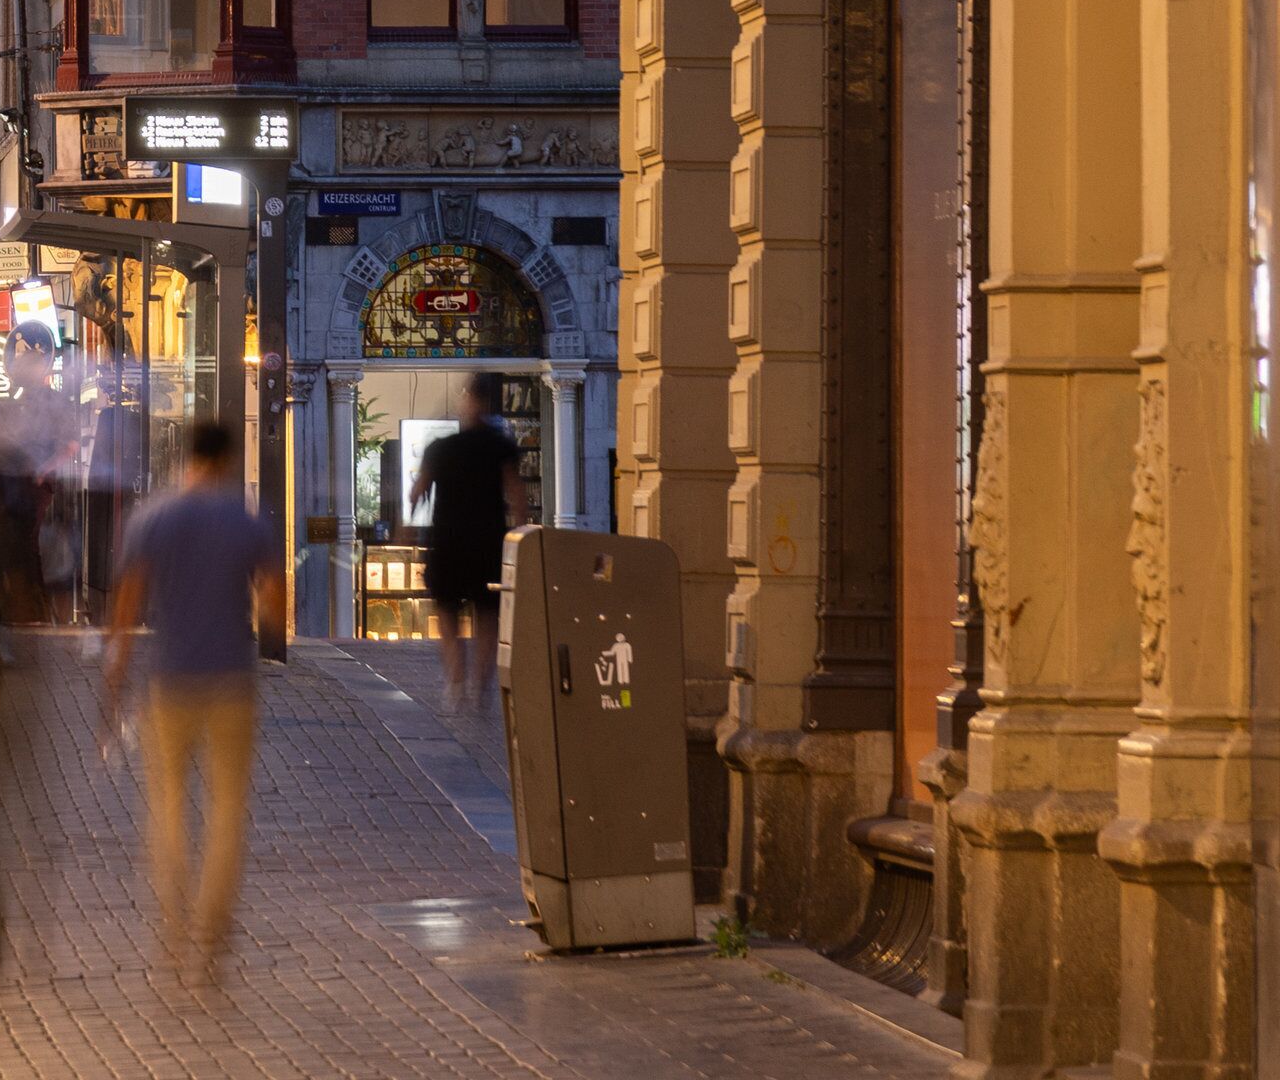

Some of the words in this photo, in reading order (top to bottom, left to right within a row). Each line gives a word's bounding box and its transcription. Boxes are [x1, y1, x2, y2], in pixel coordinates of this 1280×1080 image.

[147, 116, 155, 127] 2
[260, 116, 269, 127] 2
[270, 116, 288, 127] min
[270, 126, 288, 137] min
[147, 137, 155, 148] 2
[270, 137, 288, 148] min
[323, 193, 396, 204] KEIZERSGRACHT
